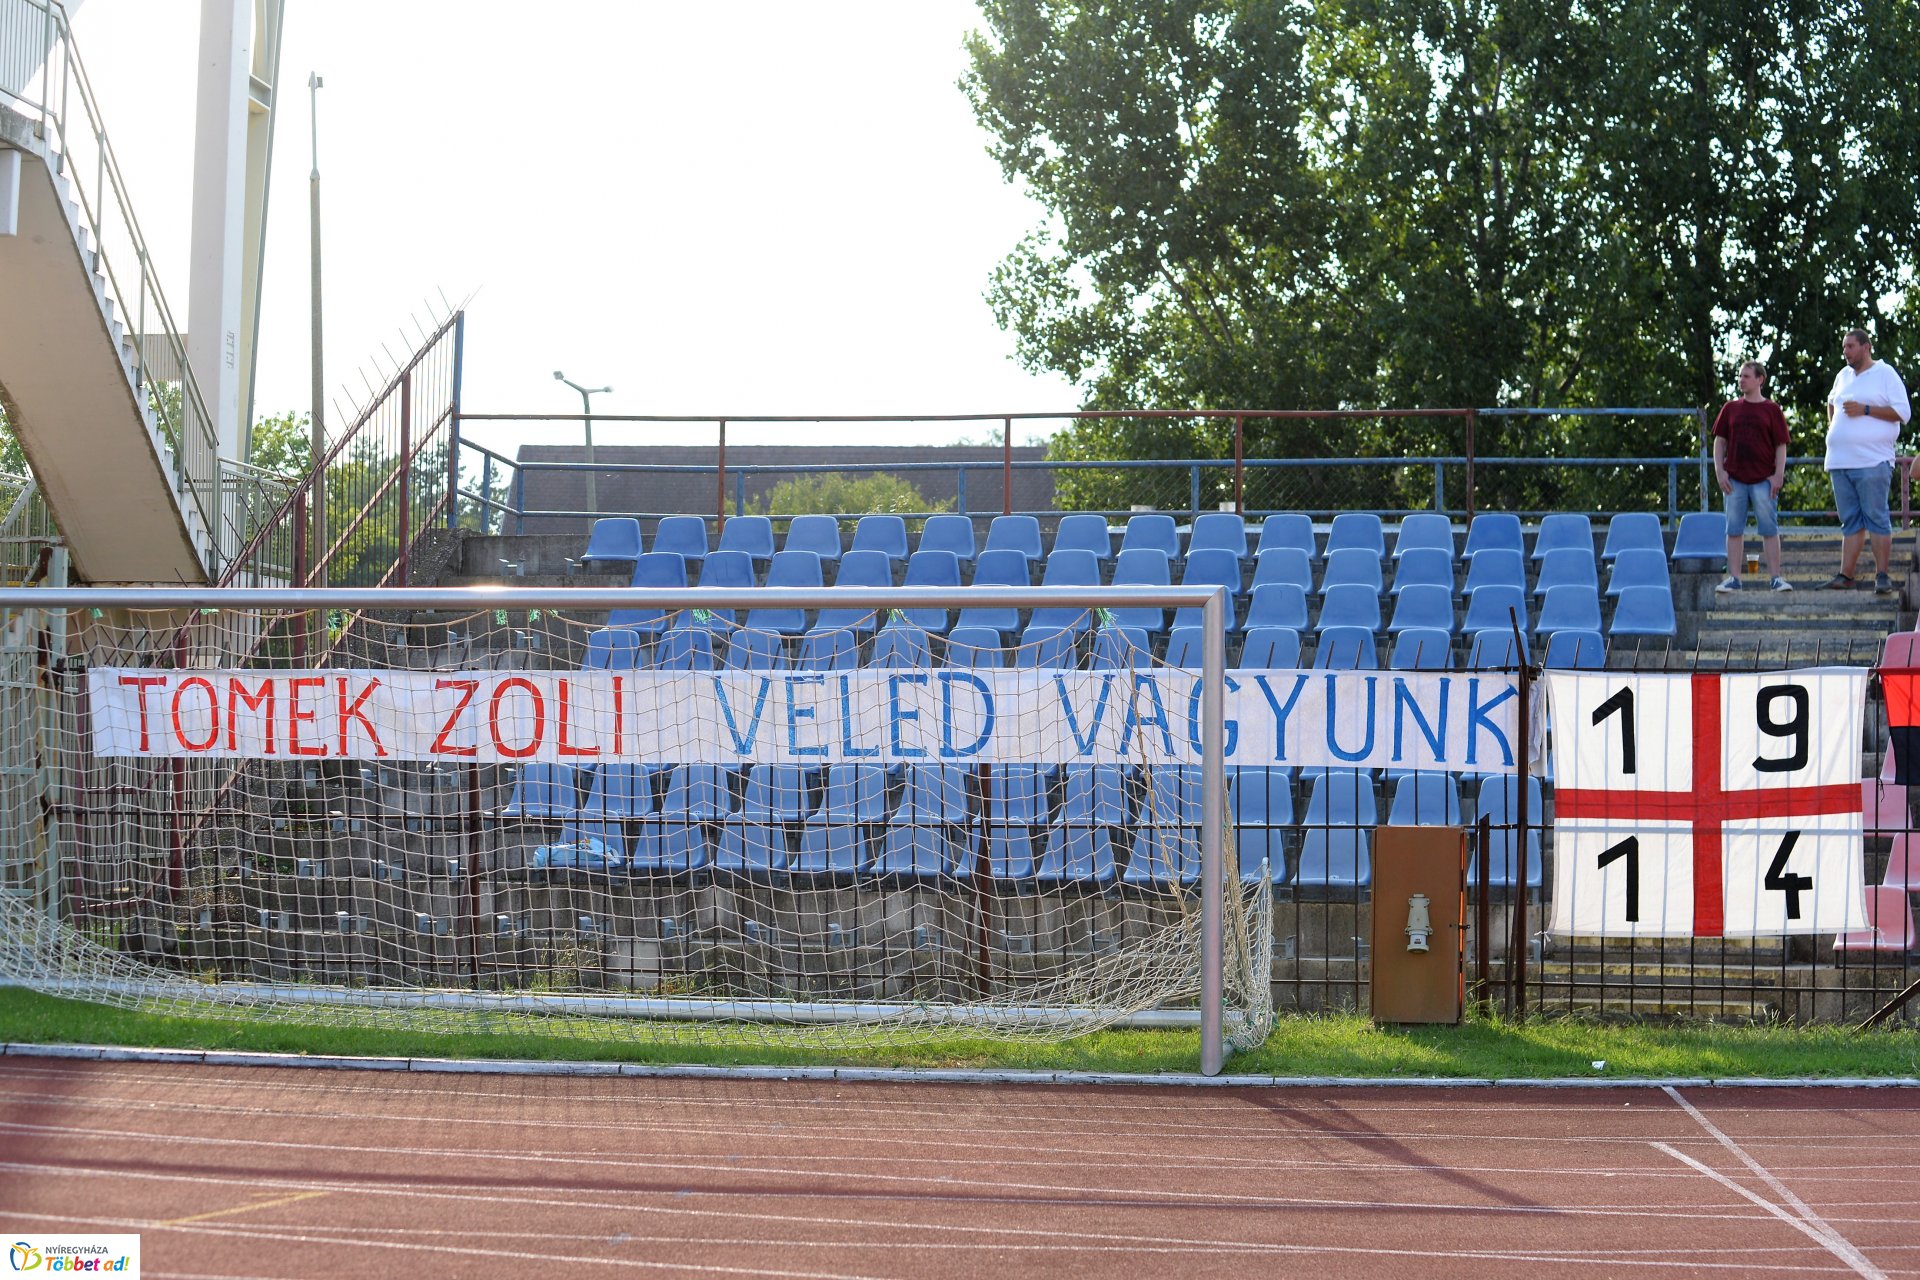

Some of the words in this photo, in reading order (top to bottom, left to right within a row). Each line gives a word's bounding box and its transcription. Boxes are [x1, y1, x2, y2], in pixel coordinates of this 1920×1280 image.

[118, 675, 388, 757] TOMEK
[430, 676, 624, 758] ZOLI
[713, 673, 995, 760] VELED
[1592, 686, 1636, 774] 1
[1752, 684, 1809, 773] 9
[1597, 835, 1639, 923] 1
[1764, 830, 1813, 920] 4
